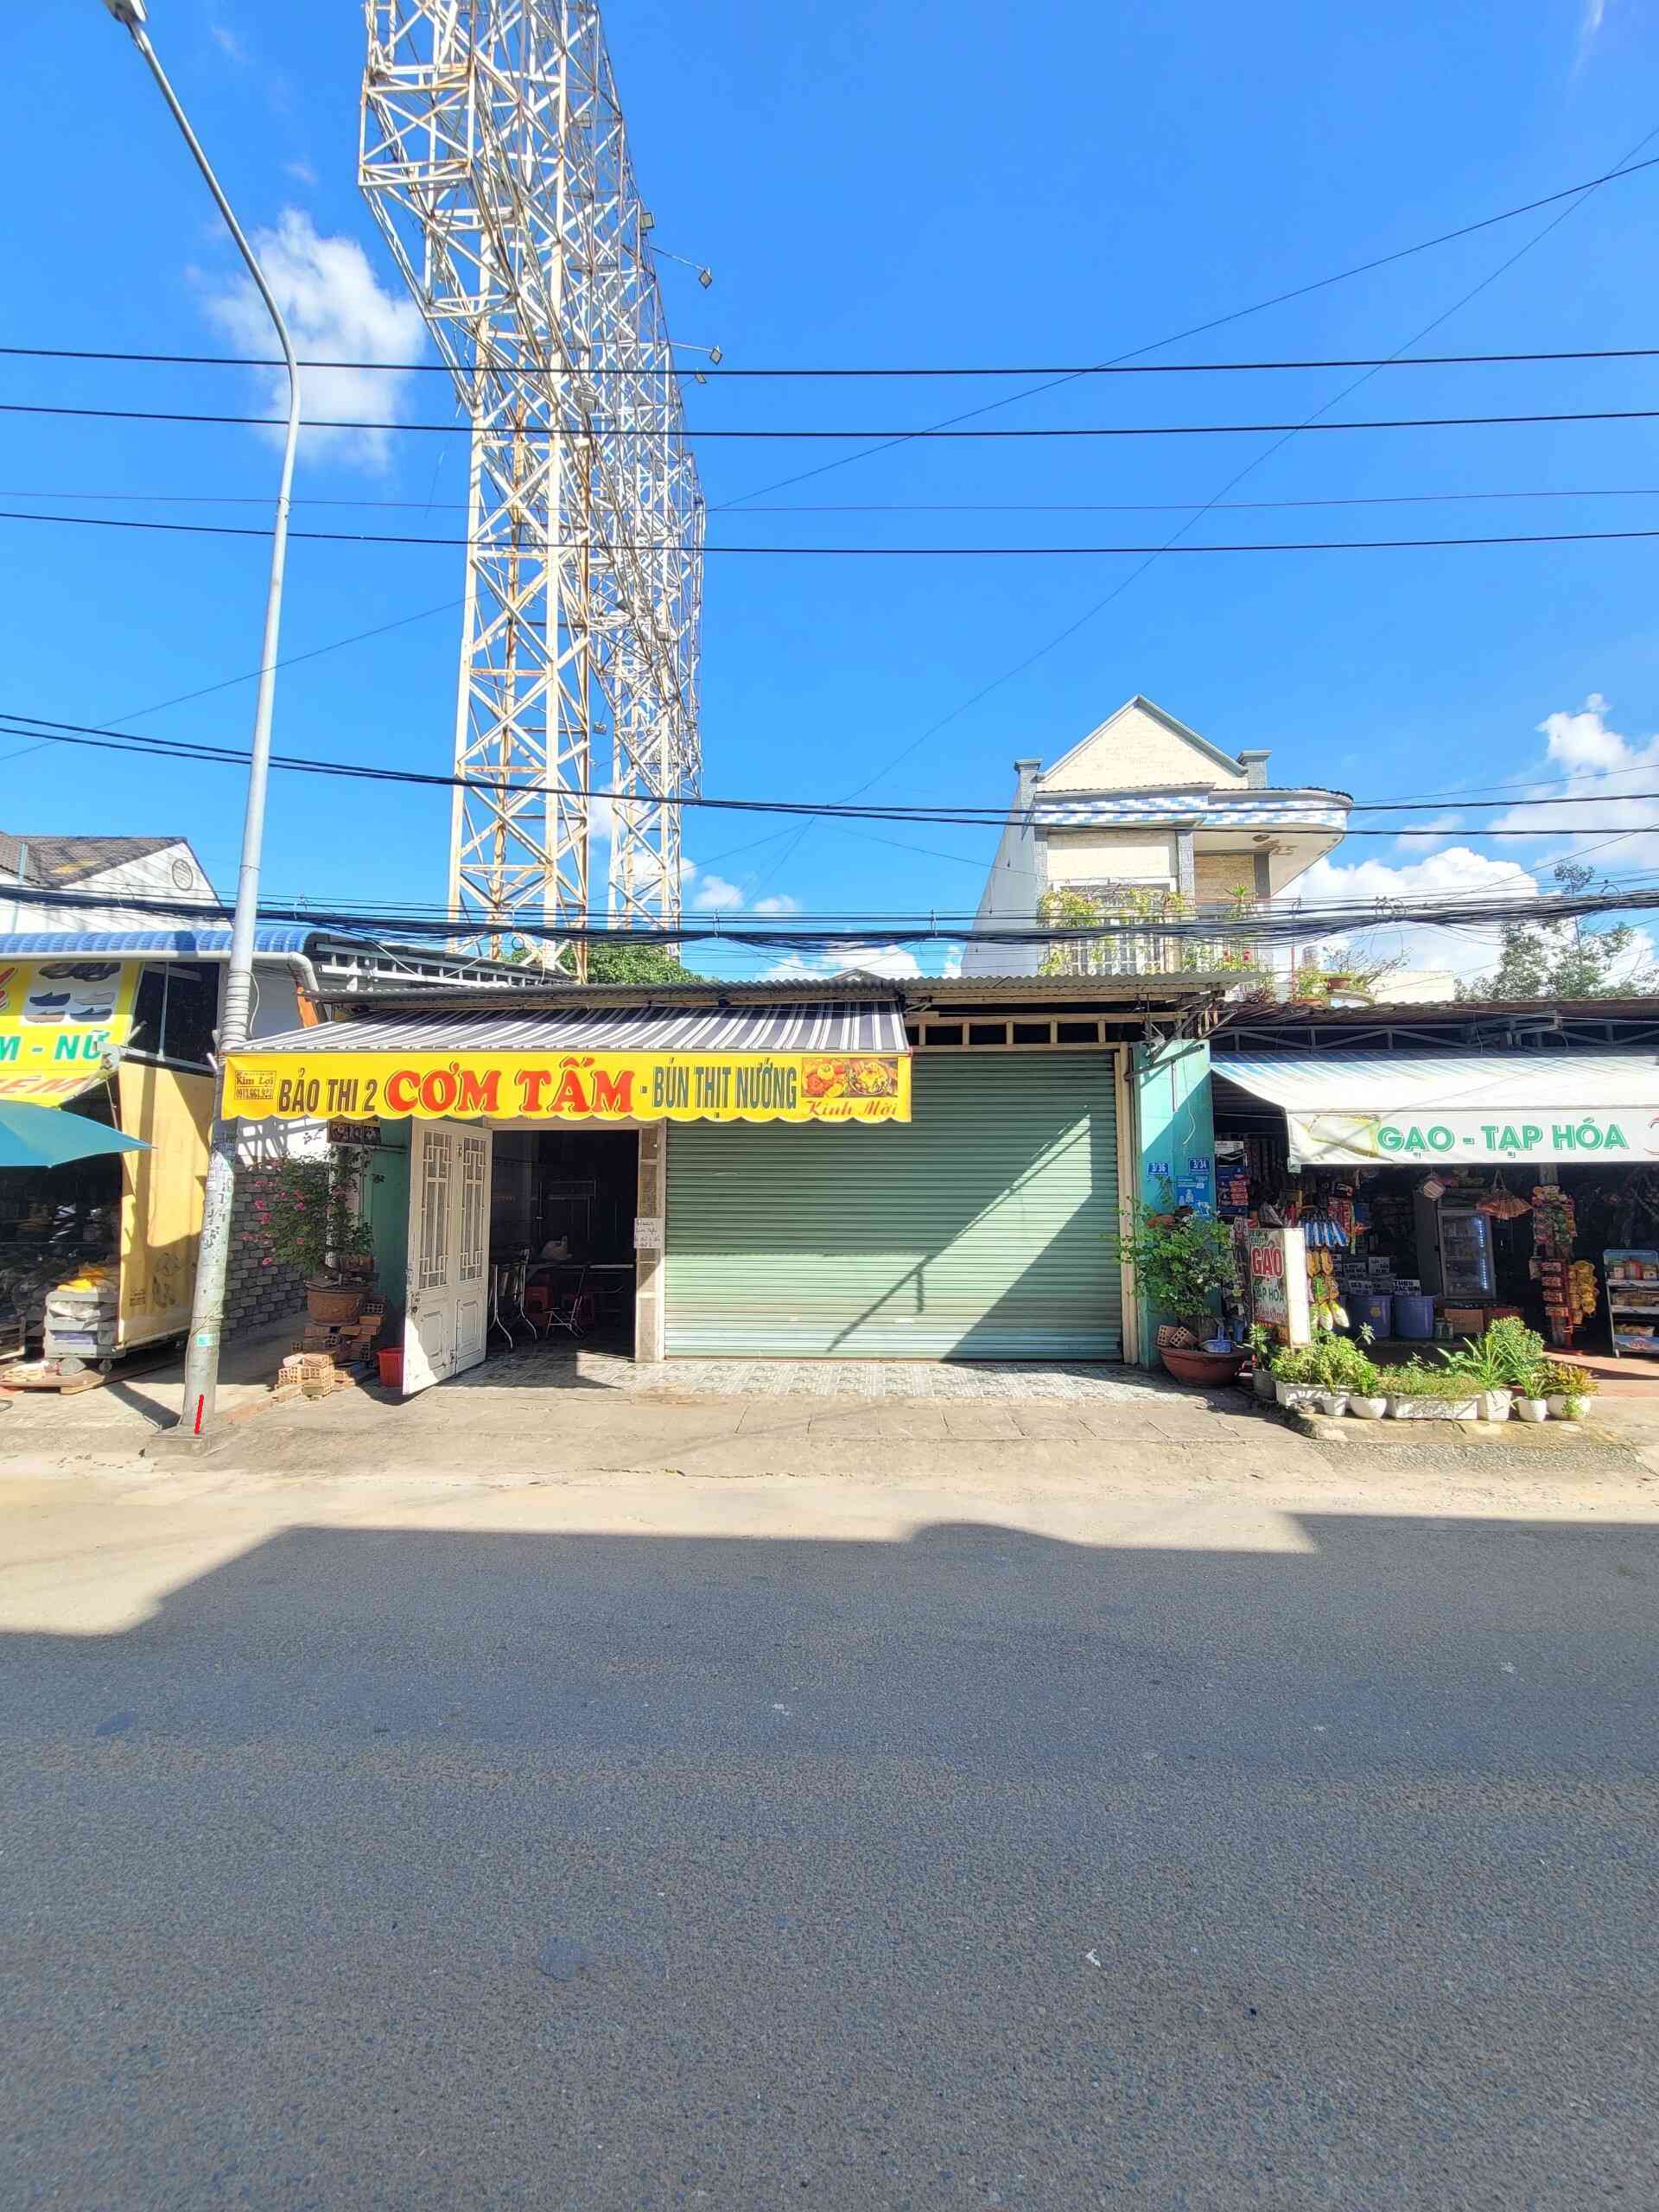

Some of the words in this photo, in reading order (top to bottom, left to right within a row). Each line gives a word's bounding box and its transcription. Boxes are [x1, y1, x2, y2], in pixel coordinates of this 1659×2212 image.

[236, 1077, 254, 1085] Kim
[277, 1068, 321, 1113] BẢO
[327, 1077, 358, 1113] THI
[363, 1077, 378, 1112] 2
[384, 1063, 502, 1113] CƠM
[516, 1057, 635, 1113] TẤM
[652, 1058, 690, 1109] BÚN
[694, 1065, 732, 1118] THỊT
[735, 1058, 798, 1109] NƯỚNG
[1377, 1126, 1457, 1159] GẠO
[1481, 1124, 1543, 1159] TẠP
[1552, 1117, 1630, 1151] HÓA
[1251, 1247, 1284, 1284] GẠO
